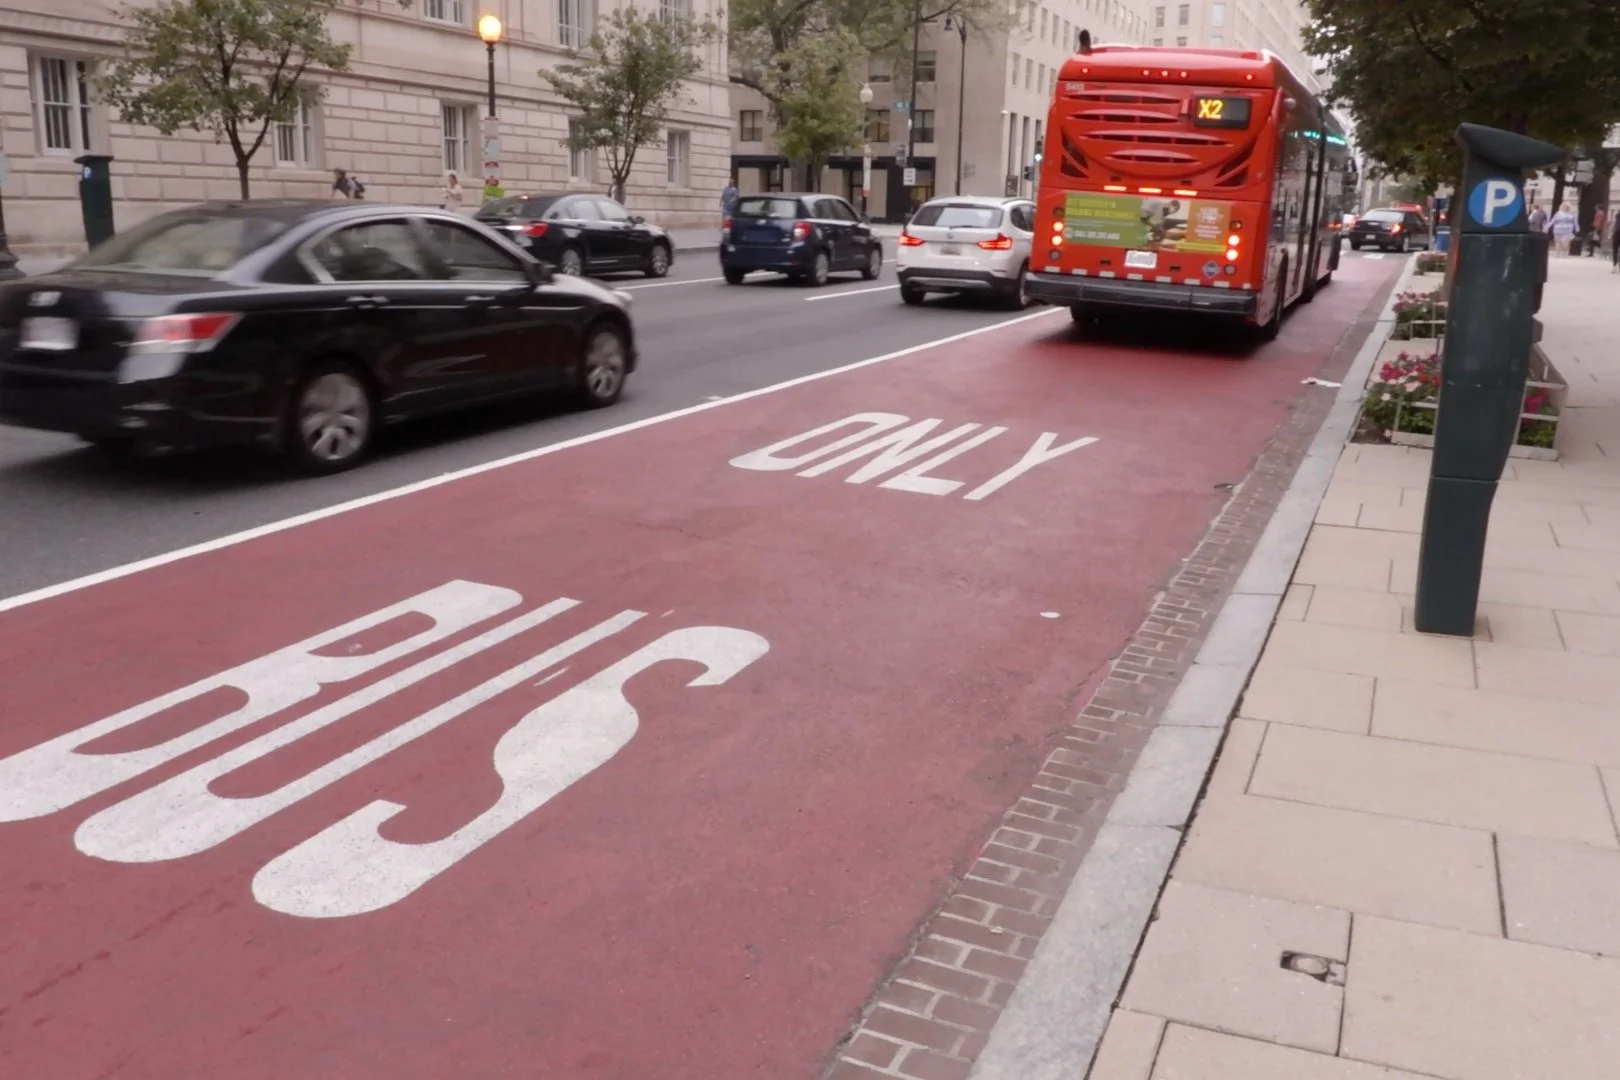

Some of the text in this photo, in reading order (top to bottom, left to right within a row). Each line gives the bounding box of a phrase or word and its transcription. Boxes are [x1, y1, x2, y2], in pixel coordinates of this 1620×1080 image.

[1198, 99, 1223, 119] X2
[1483, 180, 1516, 224] P
[728, 412, 1100, 500] ONLY
[0, 579, 770, 918] BUS
